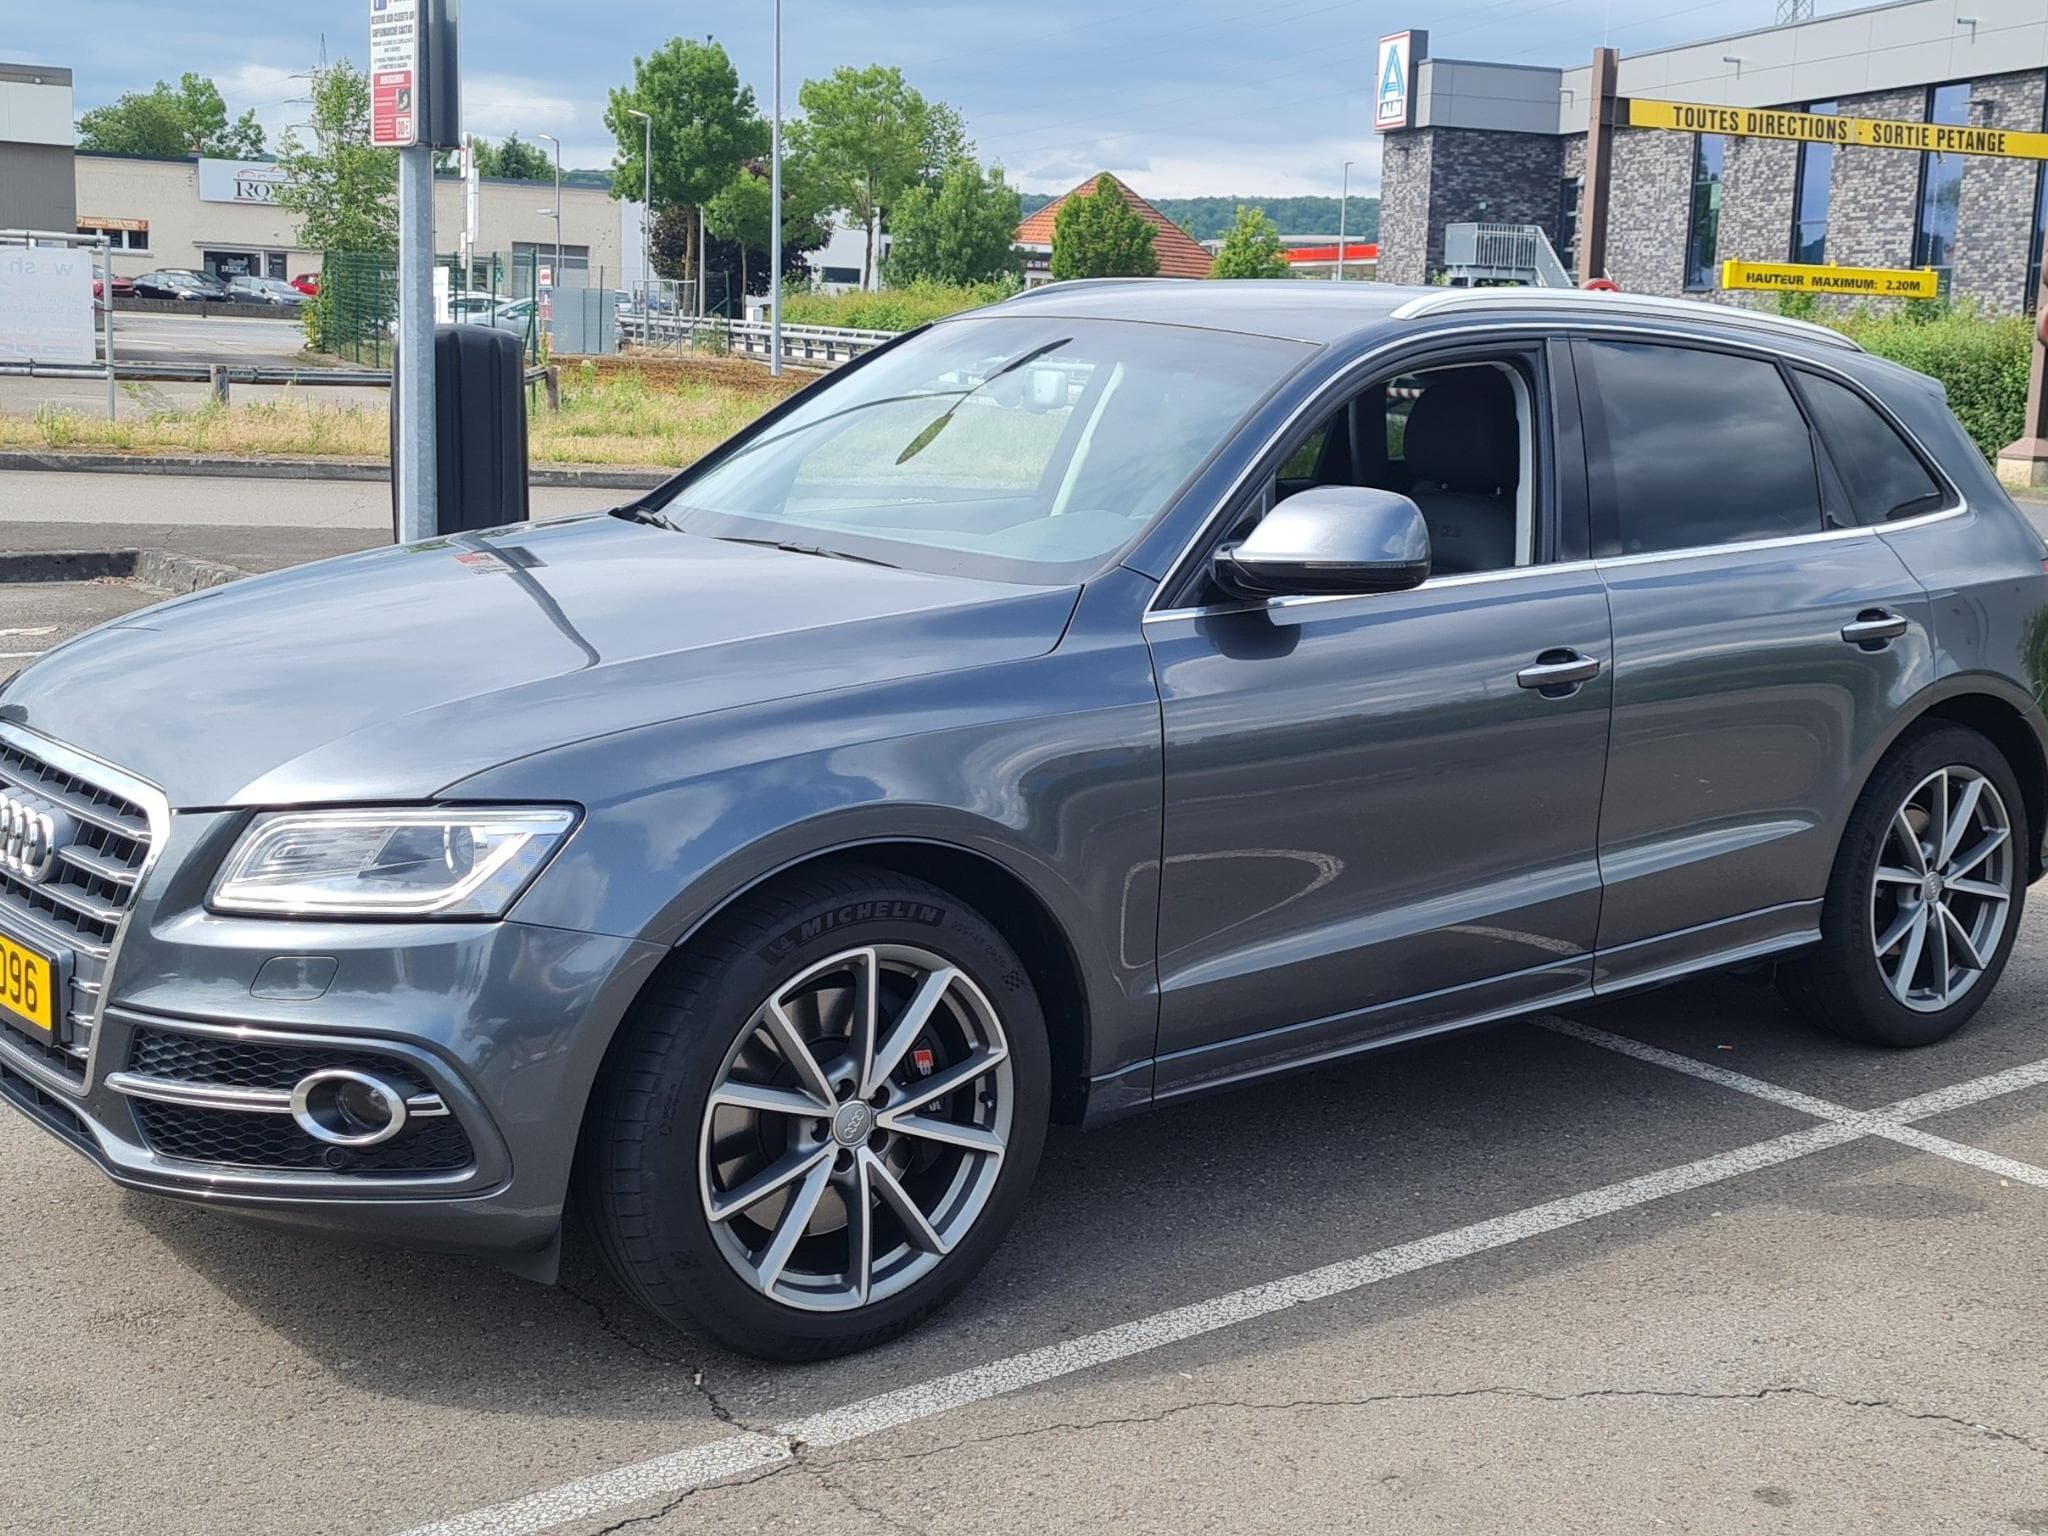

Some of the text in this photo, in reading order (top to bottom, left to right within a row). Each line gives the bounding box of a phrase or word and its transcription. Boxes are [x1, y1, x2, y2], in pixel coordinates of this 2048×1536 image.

[1673, 105, 2006, 153] TOUTES DIRECTIONS SORTIE PETANGE
[1746, 272, 1921, 291] HAUTEUR MAXIMUM: 2.20M
[801, 901, 938, 938] MICHELIN
